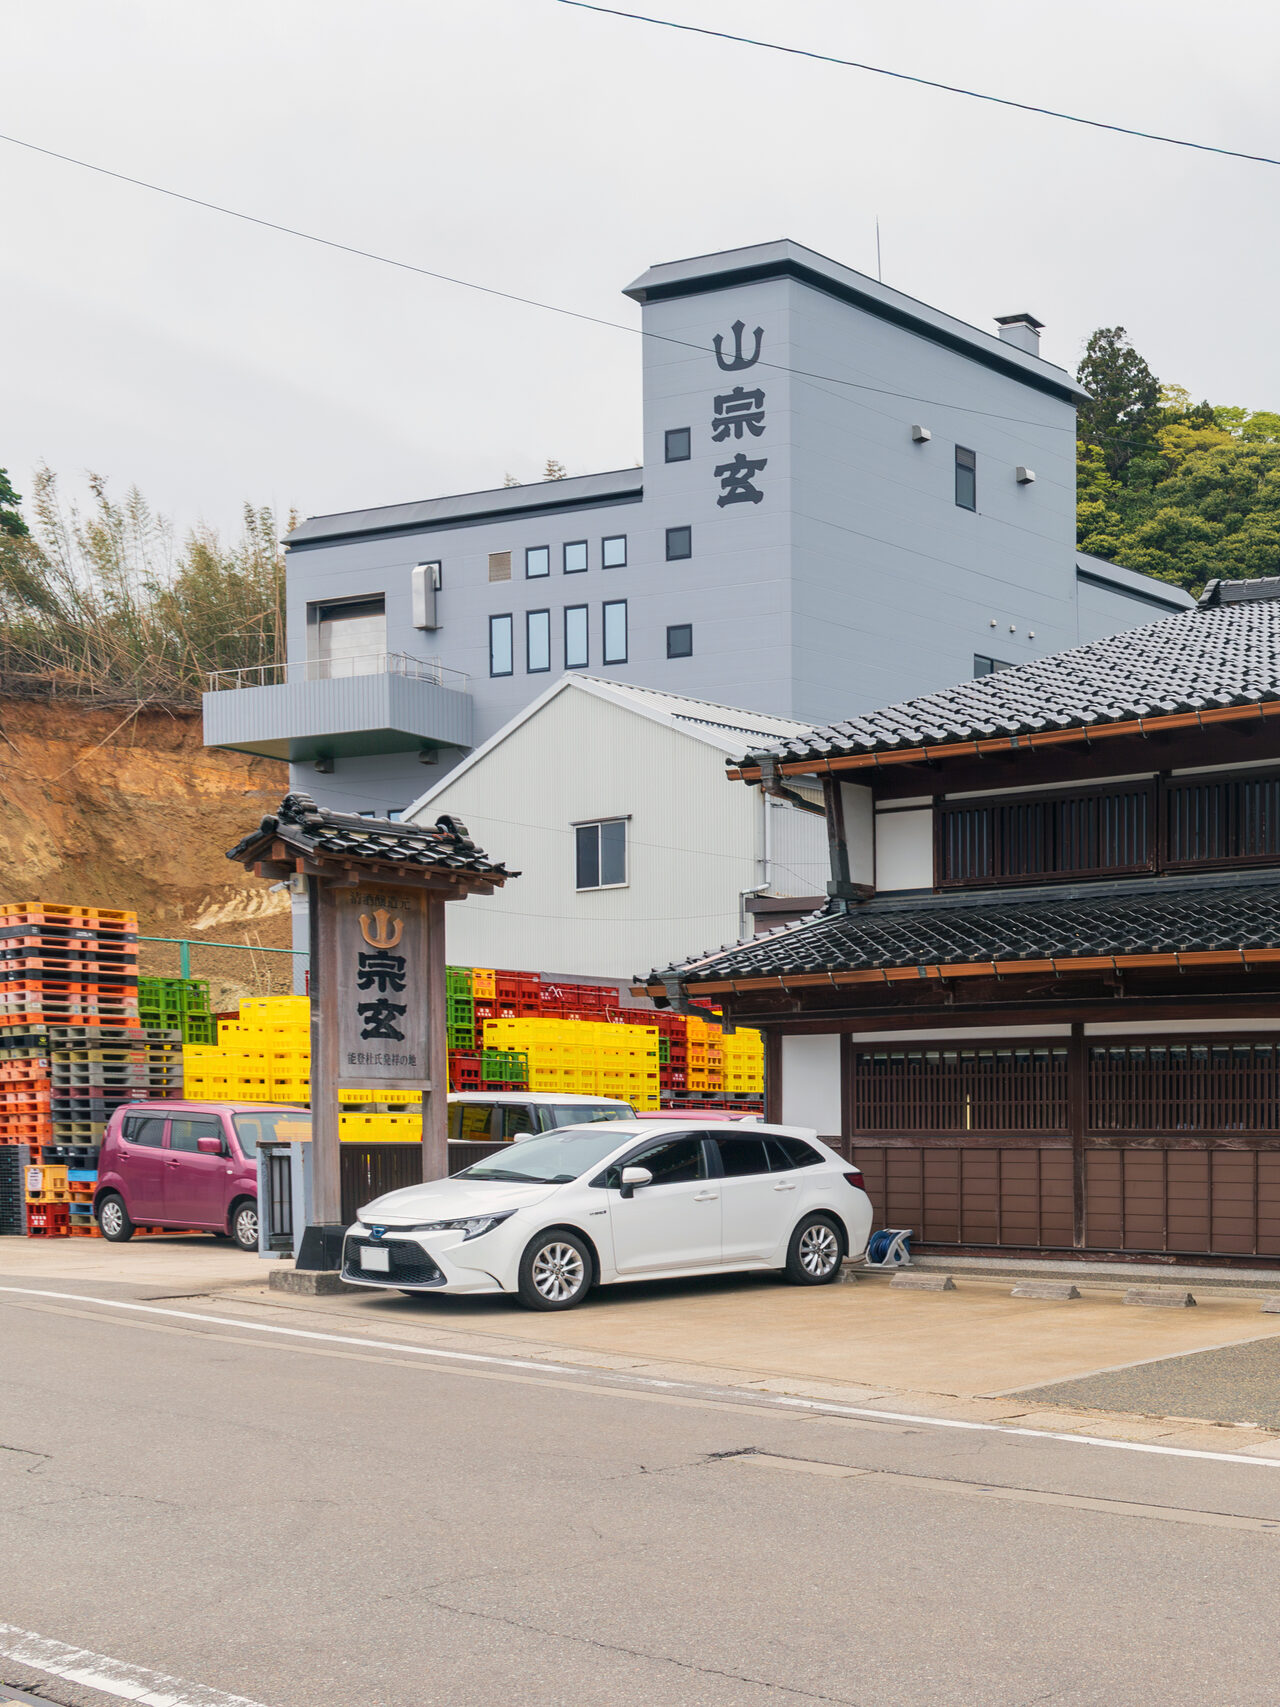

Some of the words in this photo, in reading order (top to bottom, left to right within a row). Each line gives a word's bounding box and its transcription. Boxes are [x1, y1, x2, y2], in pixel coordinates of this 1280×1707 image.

[347, 1052, 417, 1067] 能登杜氏発祥の地
